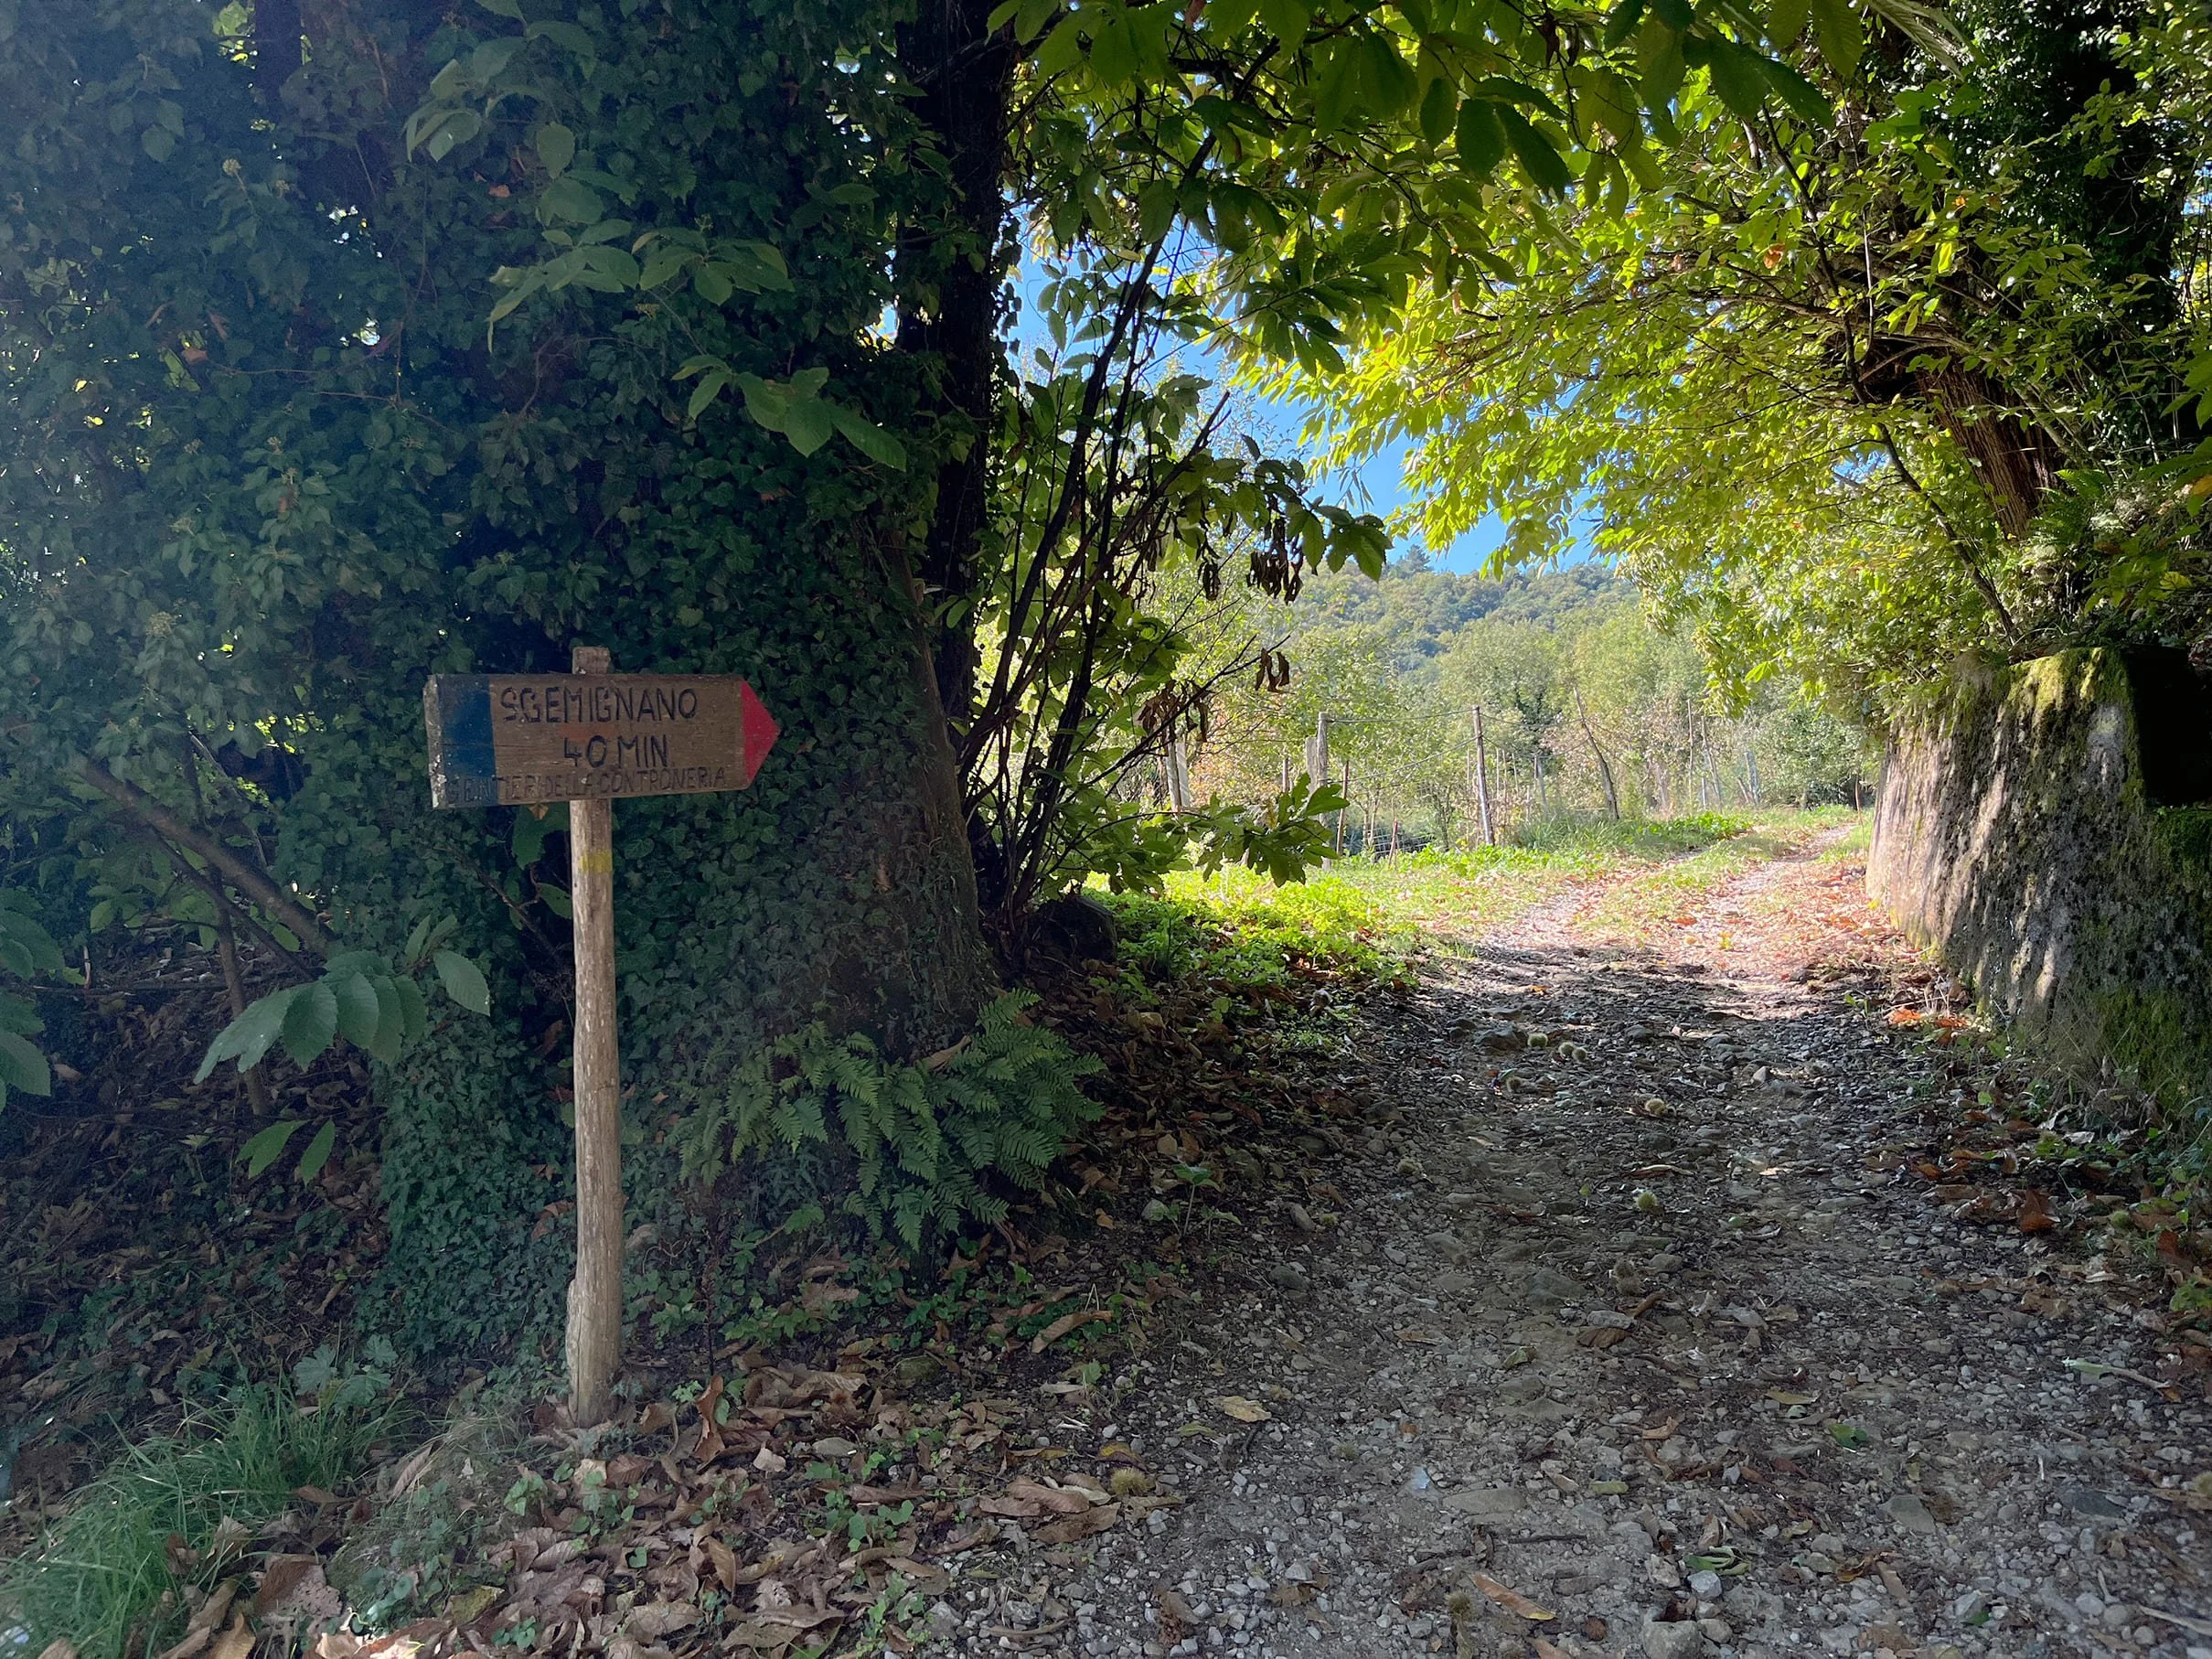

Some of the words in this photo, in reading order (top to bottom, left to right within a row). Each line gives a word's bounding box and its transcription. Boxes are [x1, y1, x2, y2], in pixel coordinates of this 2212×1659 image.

[563, 735, 608, 768] 40
[617, 733, 669, 769] MIN
[599, 766, 727, 794] CONTRONERIA
